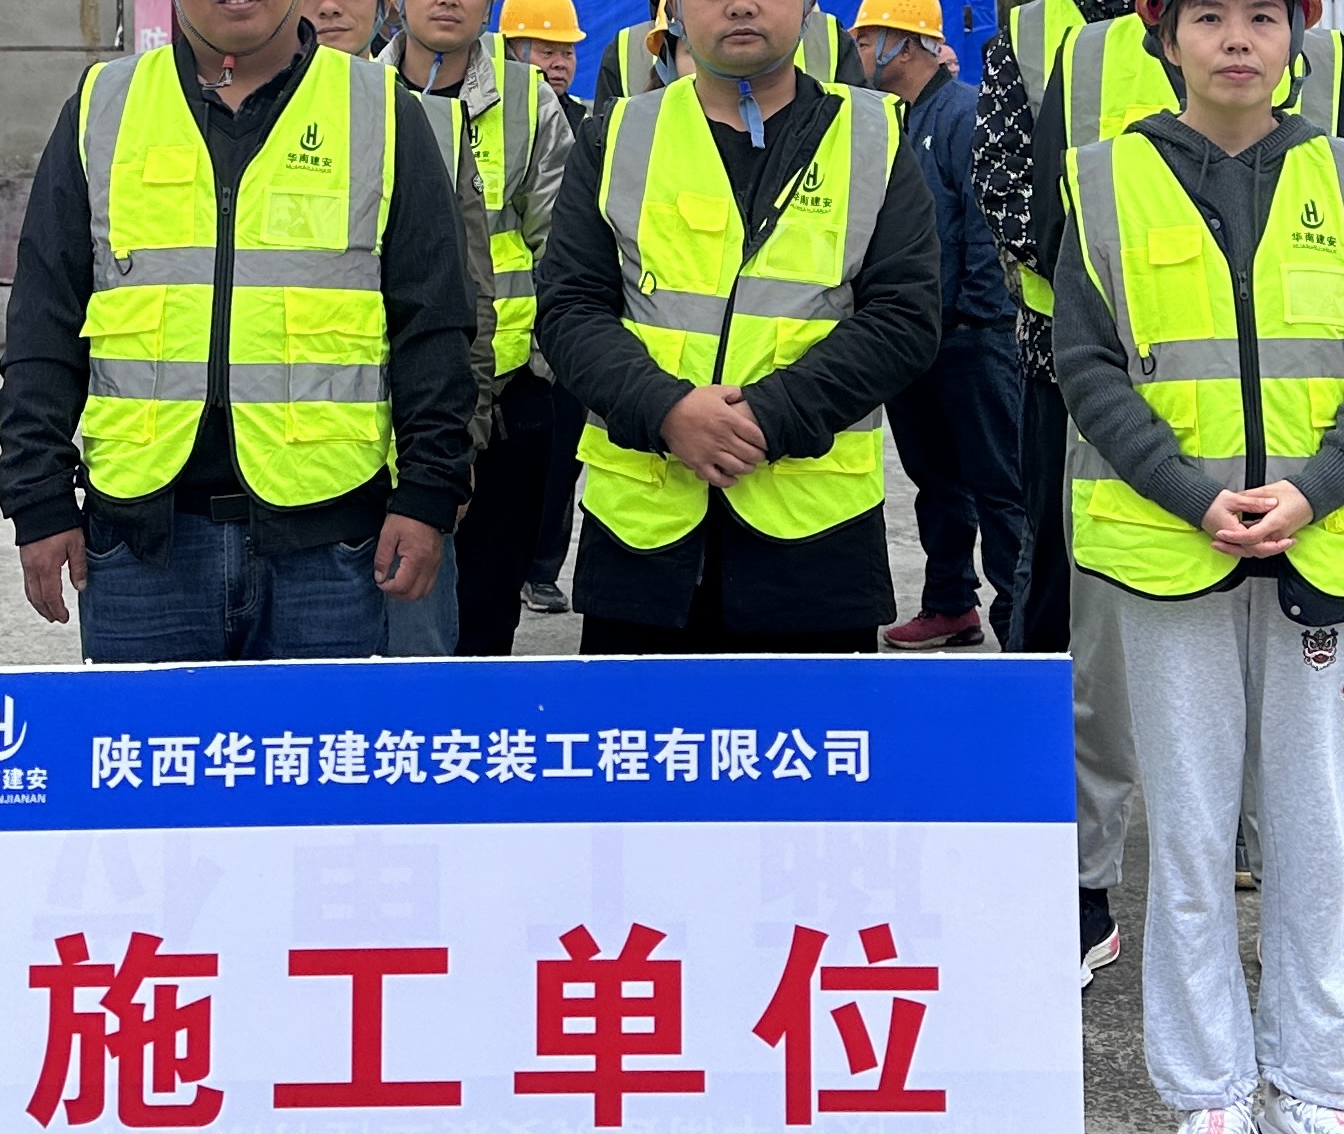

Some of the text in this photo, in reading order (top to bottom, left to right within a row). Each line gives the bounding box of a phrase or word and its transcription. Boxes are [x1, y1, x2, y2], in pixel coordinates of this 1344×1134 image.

[287, 152, 333, 167] 华南建安
[1291, 231, 1337, 247] 华南建安
[90, 727, 872, 788] 陕西华南建筑安装工程有限公司
[25, 922, 947, 1128] 施工单位
